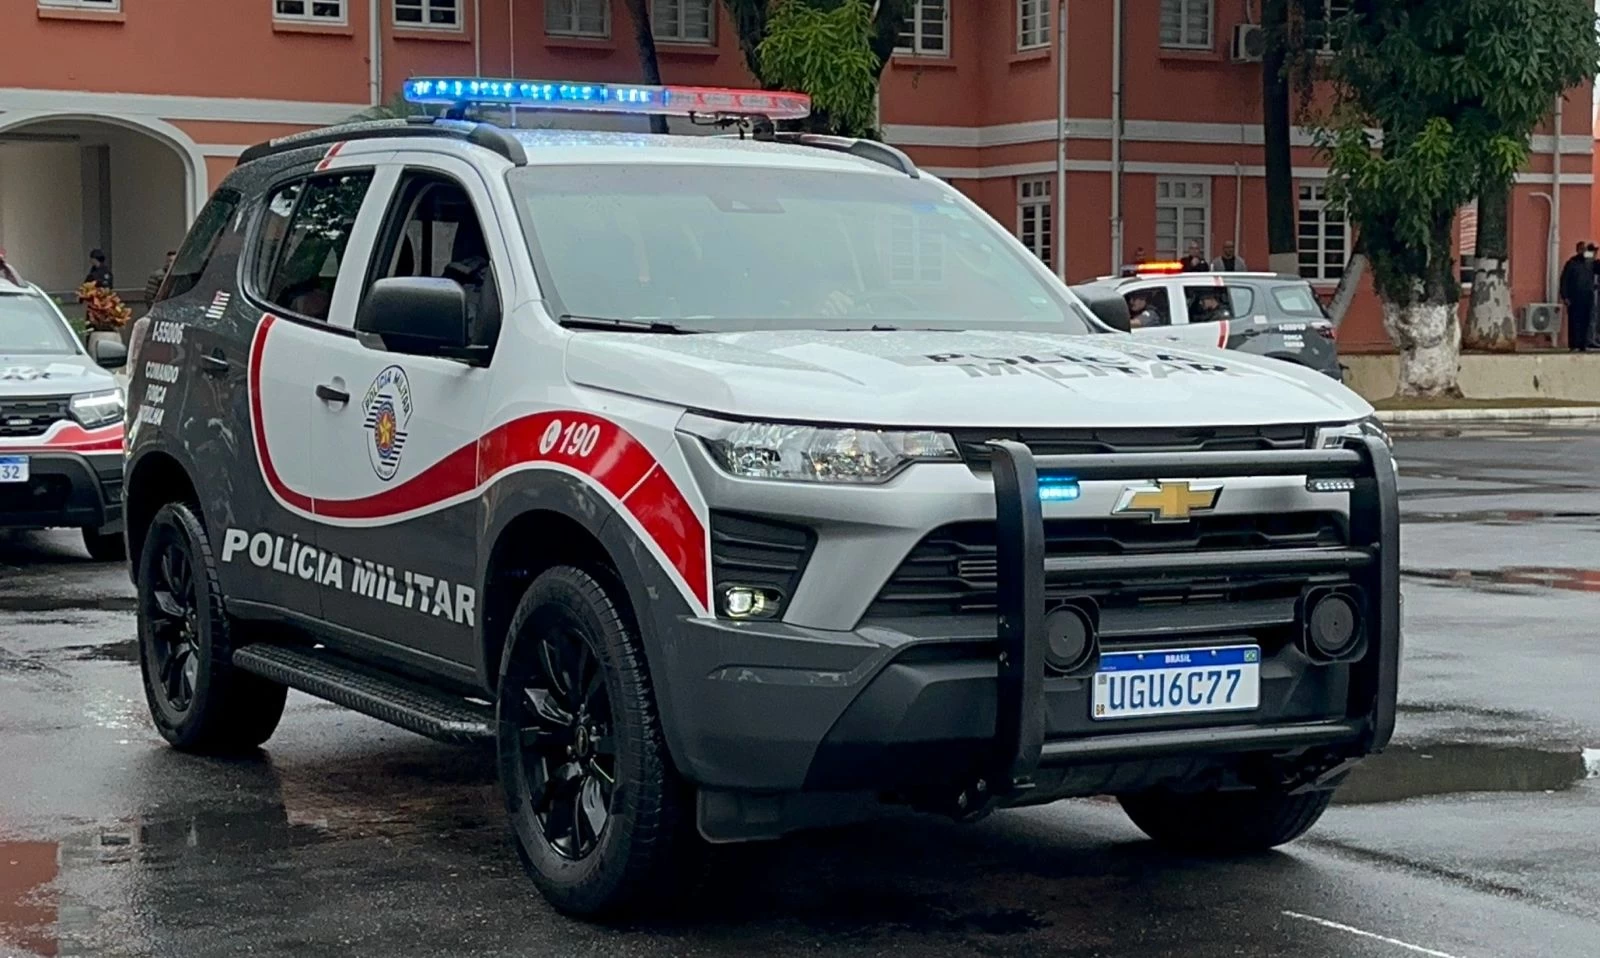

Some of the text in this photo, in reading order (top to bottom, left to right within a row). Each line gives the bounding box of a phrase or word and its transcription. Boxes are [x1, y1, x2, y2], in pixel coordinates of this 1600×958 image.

[152, 321, 184, 344] I-55006
[145, 361, 179, 383] COMANDO
[145, 384, 167, 406] FORÇA
[393, 371, 411, 416] MILITAR
[558, 421, 601, 458] 190
[221, 528, 476, 627] POLÍCIA MILITAR
[1165, 654, 1191, 664] BRASIL
[1109, 669, 1241, 710] UGU6C77
